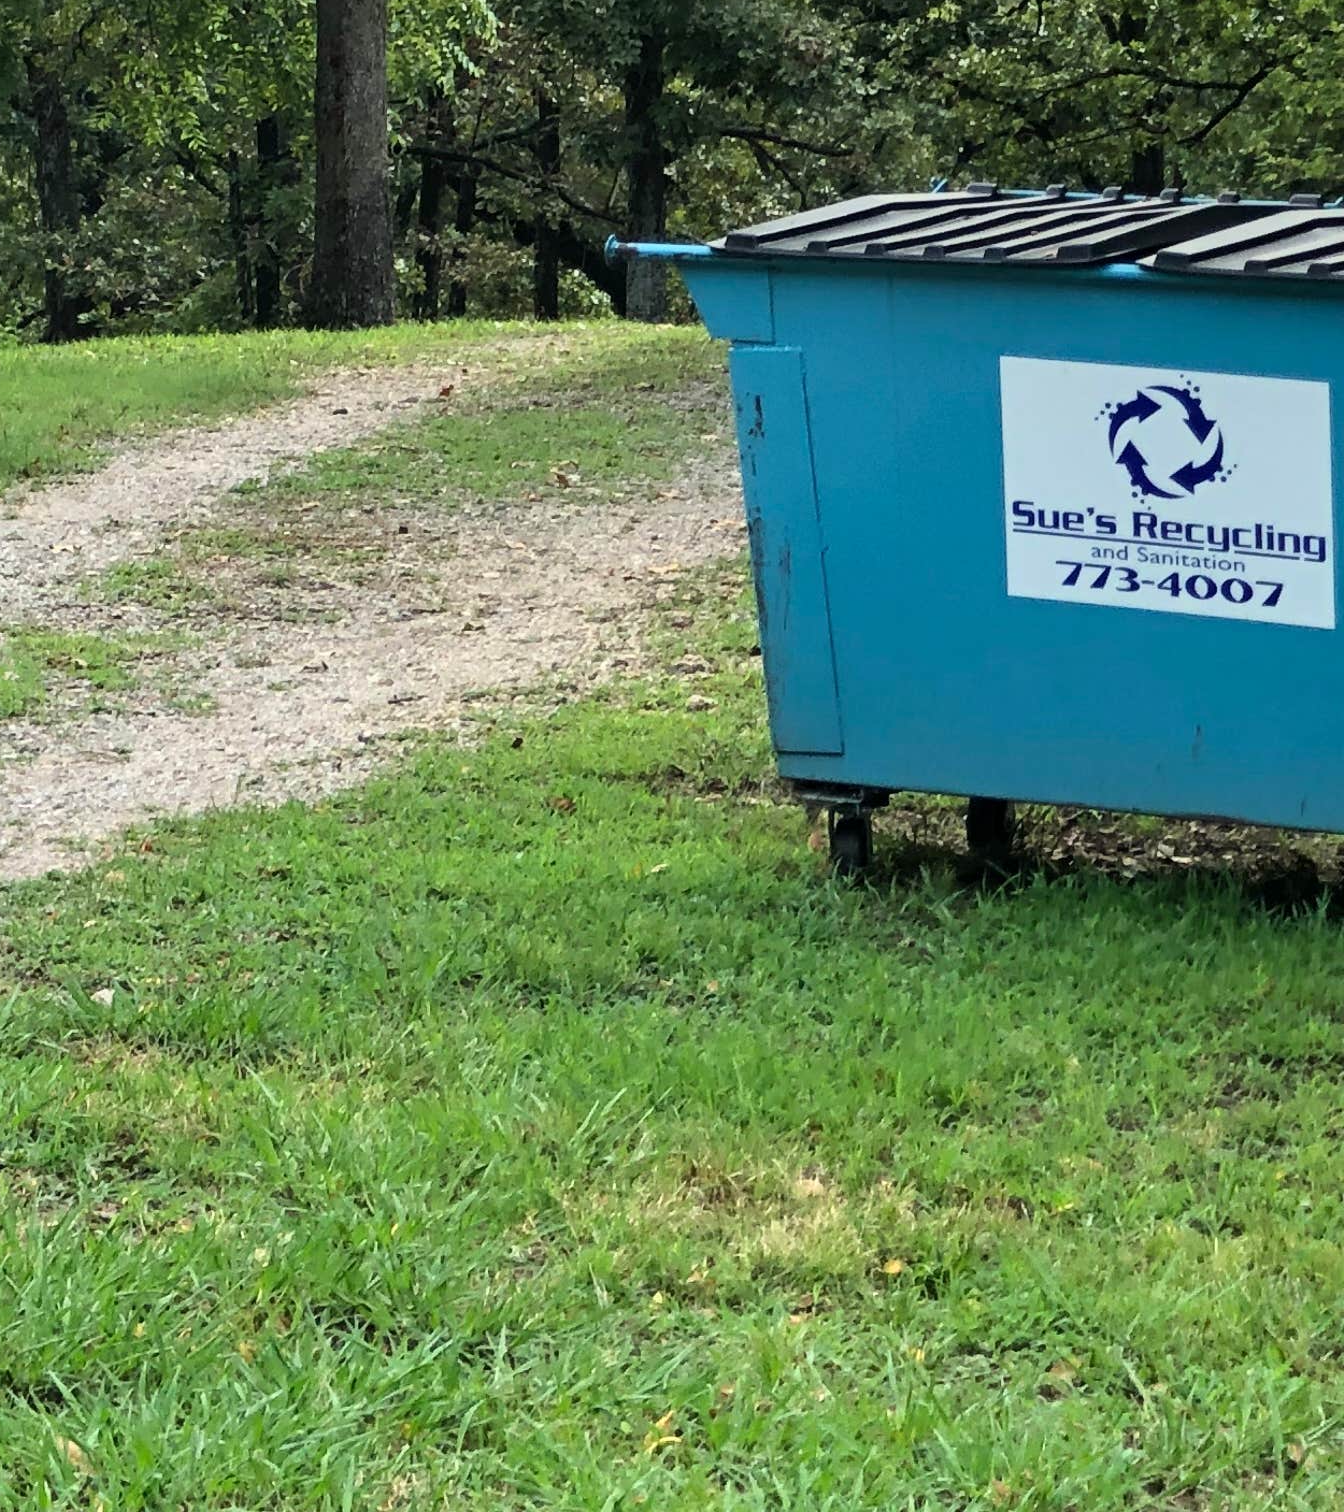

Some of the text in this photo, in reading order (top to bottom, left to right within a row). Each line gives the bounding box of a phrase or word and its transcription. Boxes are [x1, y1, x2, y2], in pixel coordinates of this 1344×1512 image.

[1012, 500, 1327, 563] Sue's Recycling
[1090, 543, 1246, 573] and Sanitation
[1055, 560, 1284, 607] 773-4007
